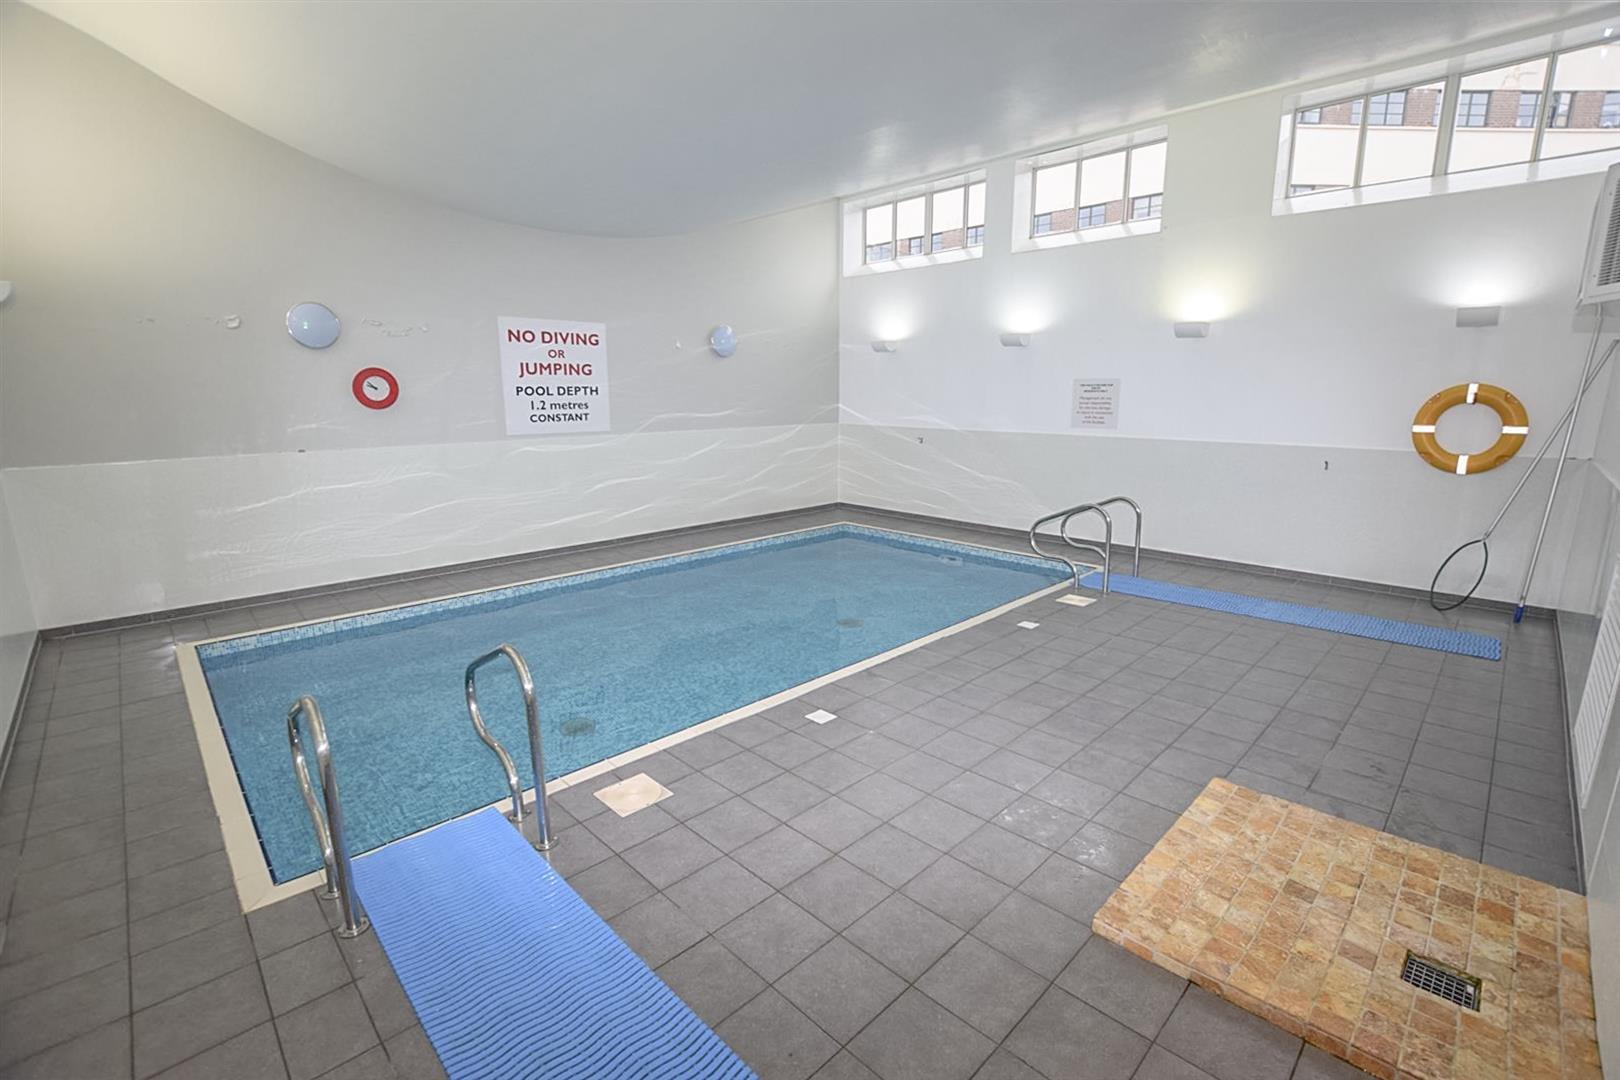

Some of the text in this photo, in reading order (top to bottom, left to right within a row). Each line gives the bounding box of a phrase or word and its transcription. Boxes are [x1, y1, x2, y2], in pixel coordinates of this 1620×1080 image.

[508, 329, 600, 346] NO DIVING
[548, 349, 566, 359] OR
[519, 362, 593, 378] JUMPING
[516, 386, 599, 396] POOL DEPTH
[530, 400, 589, 410] 1.2 metres
[530, 413, 590, 423] CONSTANT
